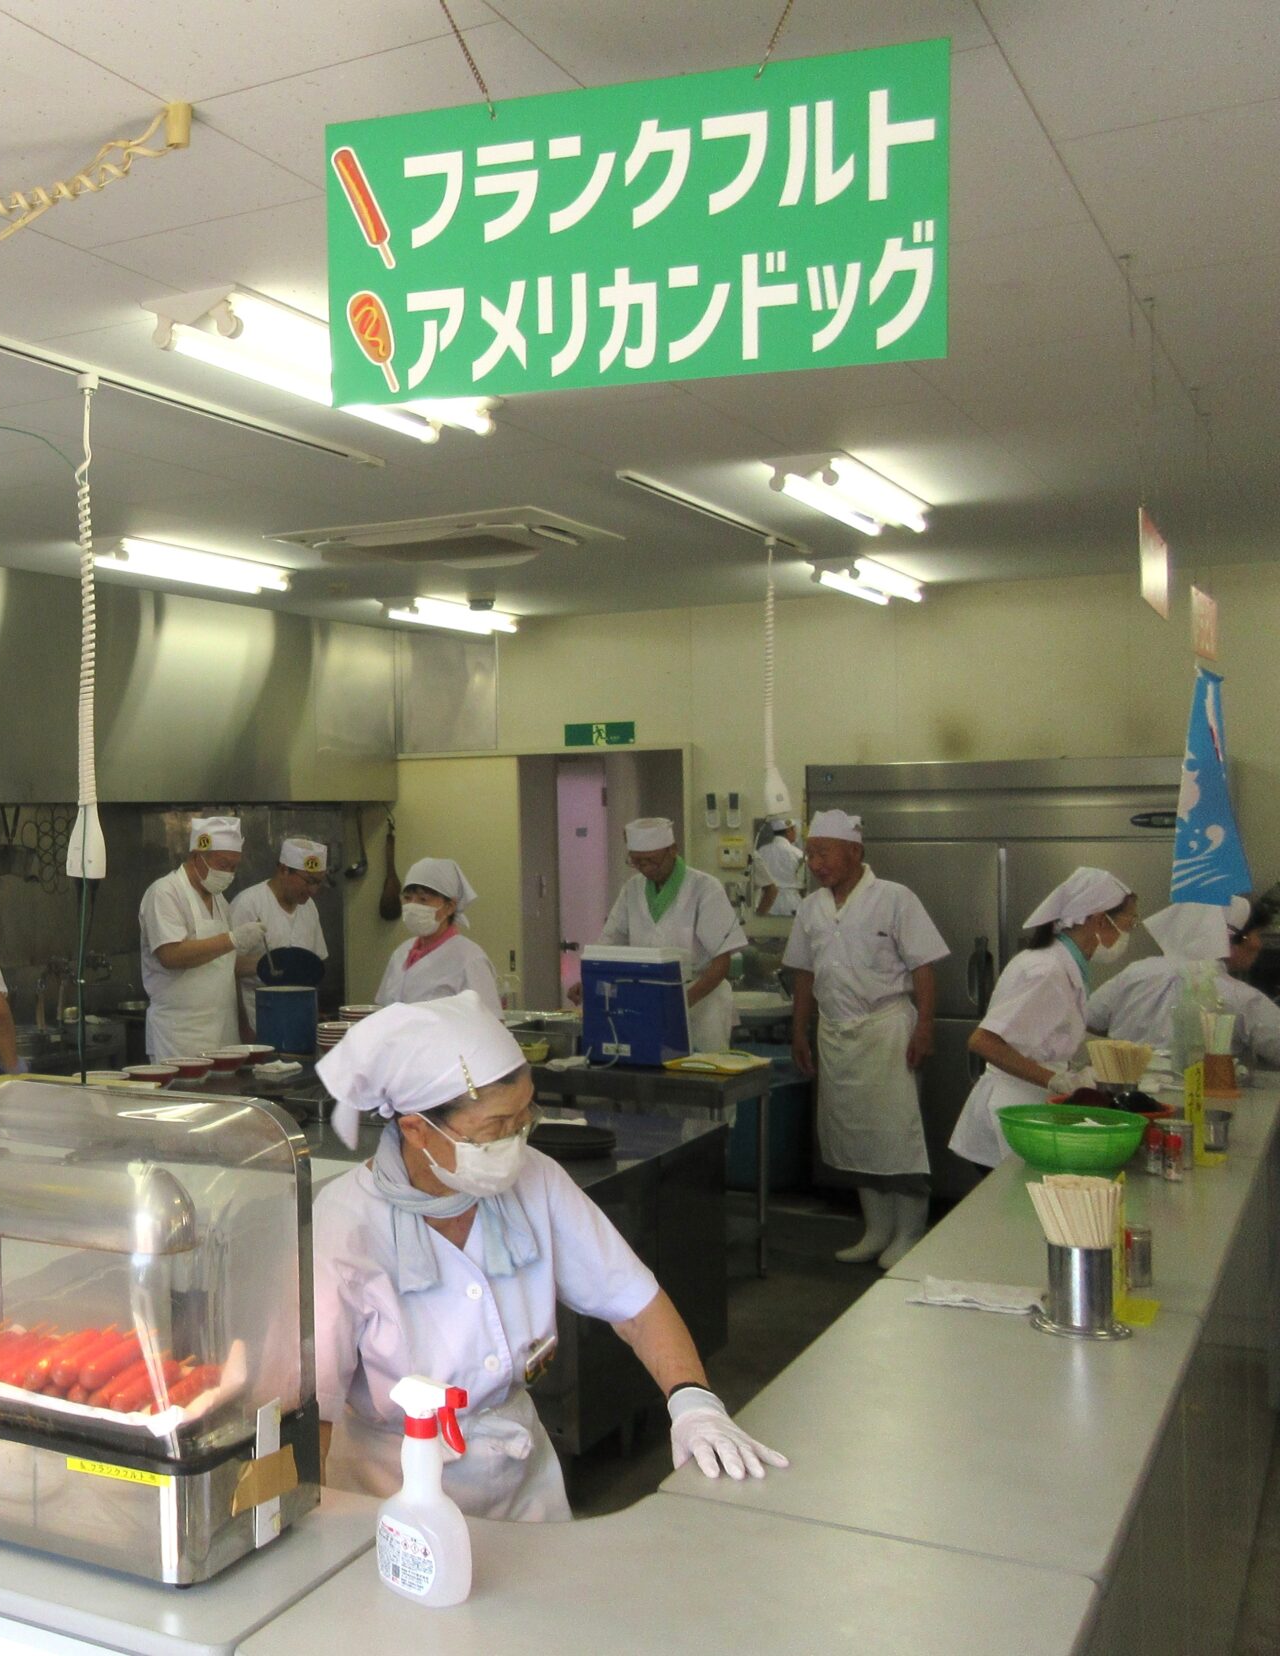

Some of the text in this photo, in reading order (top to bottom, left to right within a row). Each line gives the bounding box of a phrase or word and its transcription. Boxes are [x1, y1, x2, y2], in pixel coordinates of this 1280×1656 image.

[404, 90, 935, 249] フランクフルト
[407, 220, 935, 390] アメリカンドッグ
